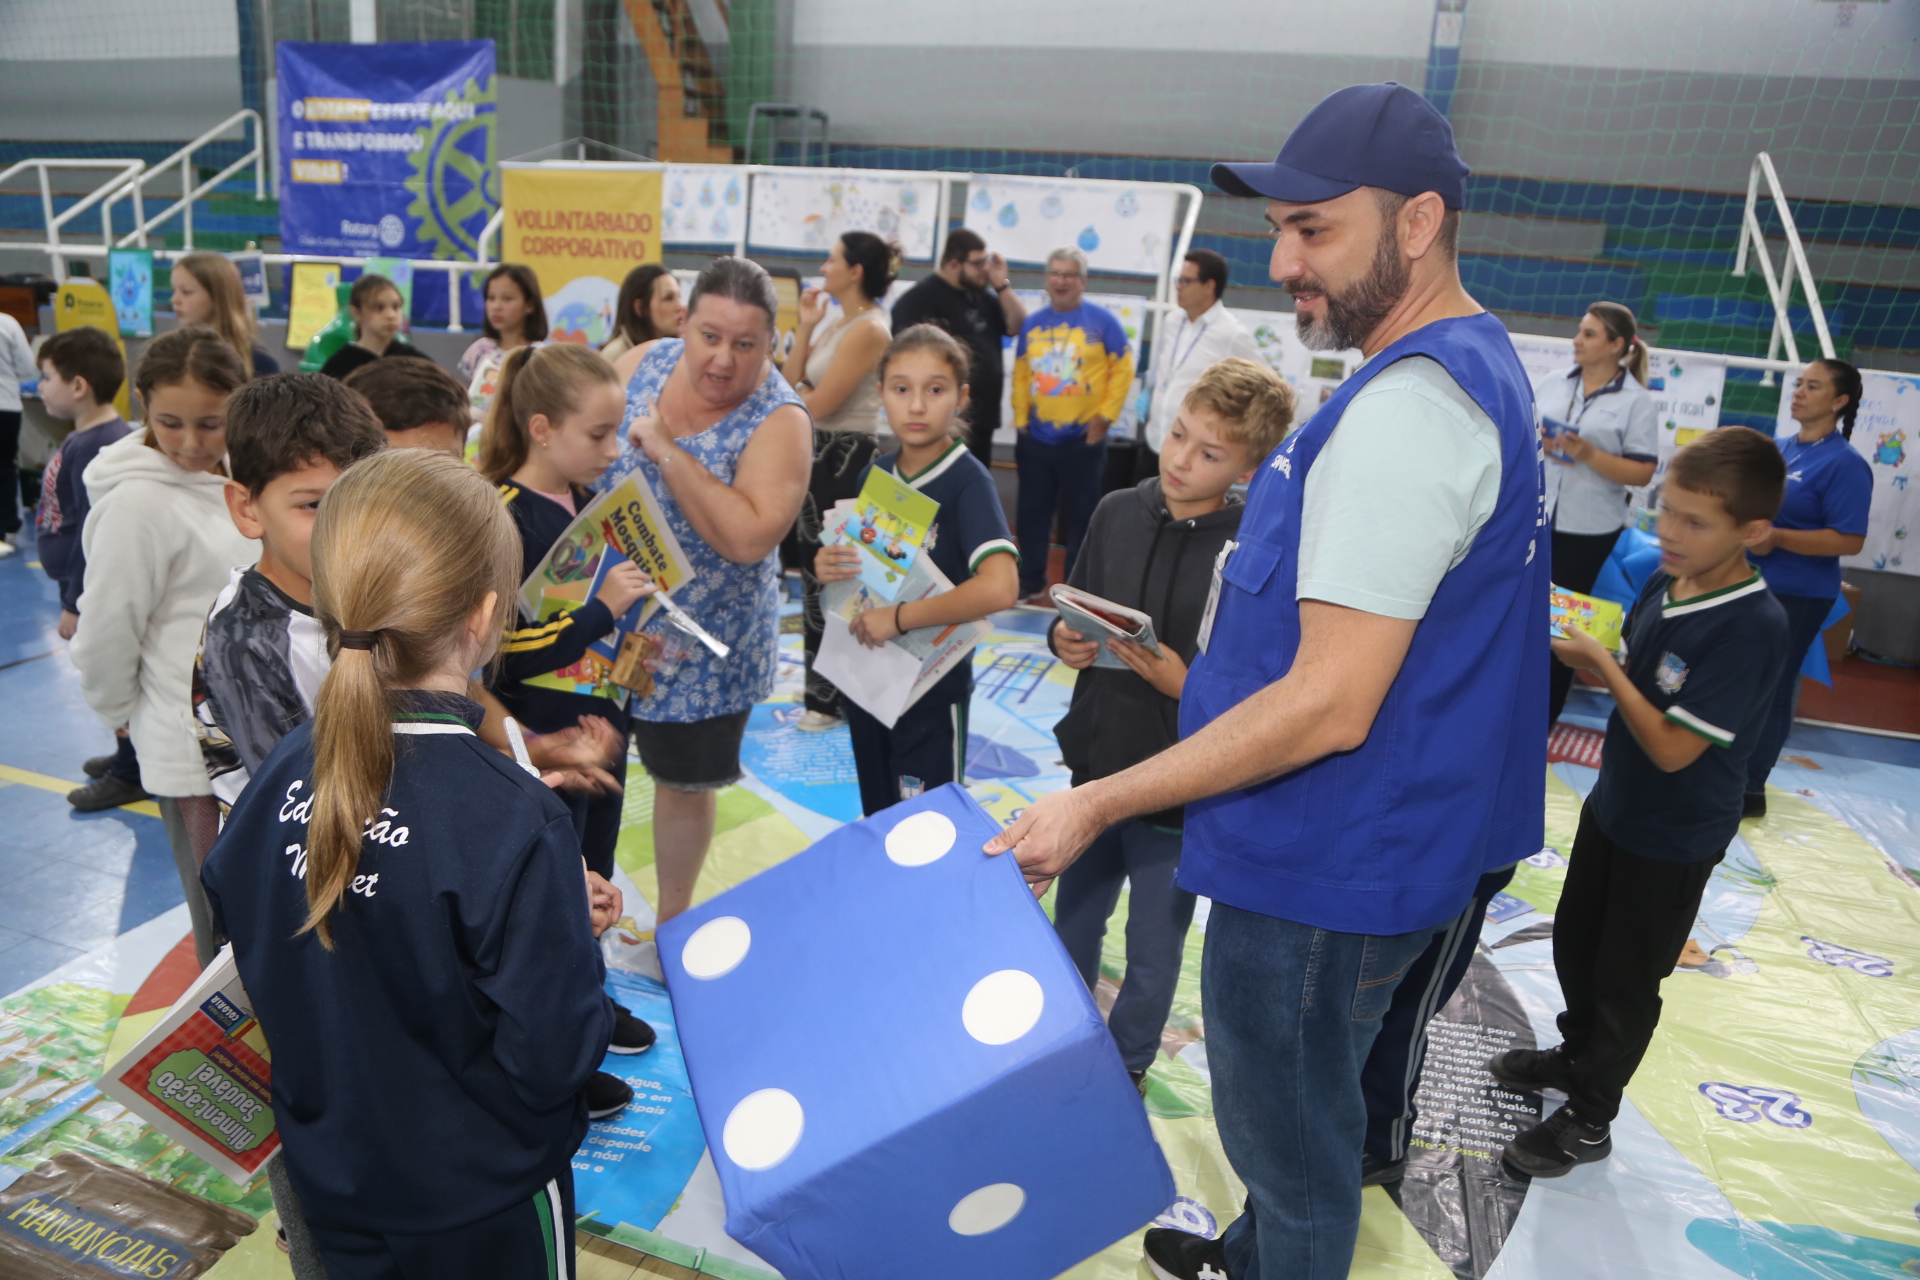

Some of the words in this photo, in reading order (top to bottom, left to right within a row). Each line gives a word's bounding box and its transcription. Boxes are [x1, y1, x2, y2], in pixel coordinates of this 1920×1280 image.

[292, 100, 305, 119] O
[293, 131, 304, 150] E
[306, 131, 424, 152] TRANSFORMOU
[341, 219, 379, 240] Rotary
[513, 208, 653, 234] VOLUNTARIADO
[521, 235, 645, 260] CORPORATIVO
[600, 506, 656, 584] Mosquit
[628, 501, 668, 571] Combate
[210, 995, 240, 1022] COLORIR
[1441, 1029, 1511, 1046] mananciais
[1487, 1026, 1517, 1037] para
[1460, 1038, 1475, 1048] de
[1434, 1061, 1494, 1077] transform
[625, 1075, 663, 1091] água,
[1438, 1081, 1475, 1094] retém
[1480, 1088, 1488, 1096] e
[1490, 1089, 1524, 1101] filtra
[1451, 1075, 1499, 1088] espécie
[188, 1061, 265, 1124] Saudável
[650, 1094, 673, 1103] em
[156, 1070, 257, 1150] Alimentação
[1443, 1101, 1500, 1118] incêndio
[1471, 1096, 1494, 1106] Um
[1497, 1100, 1538, 1115] balão
[1698, 1082, 1812, 1129] 23
[1429, 1109, 1455, 1120] boa
[1460, 1115, 1495, 1128] parte
[1499, 1121, 1518, 1132] da
[1412, 1127, 1505, 1151] bastecimento
[1435, 1120, 1453, 1130] do
[1460, 1126, 1516, 1142] mananci
[588, 1135, 652, 1153] depende
[1438, 1142, 1447, 1152] 3
[592, 1150, 625, 1162] nós!
[594, 1165, 605, 1173] e
[7, 1197, 179, 1279] MANANCIAIS
